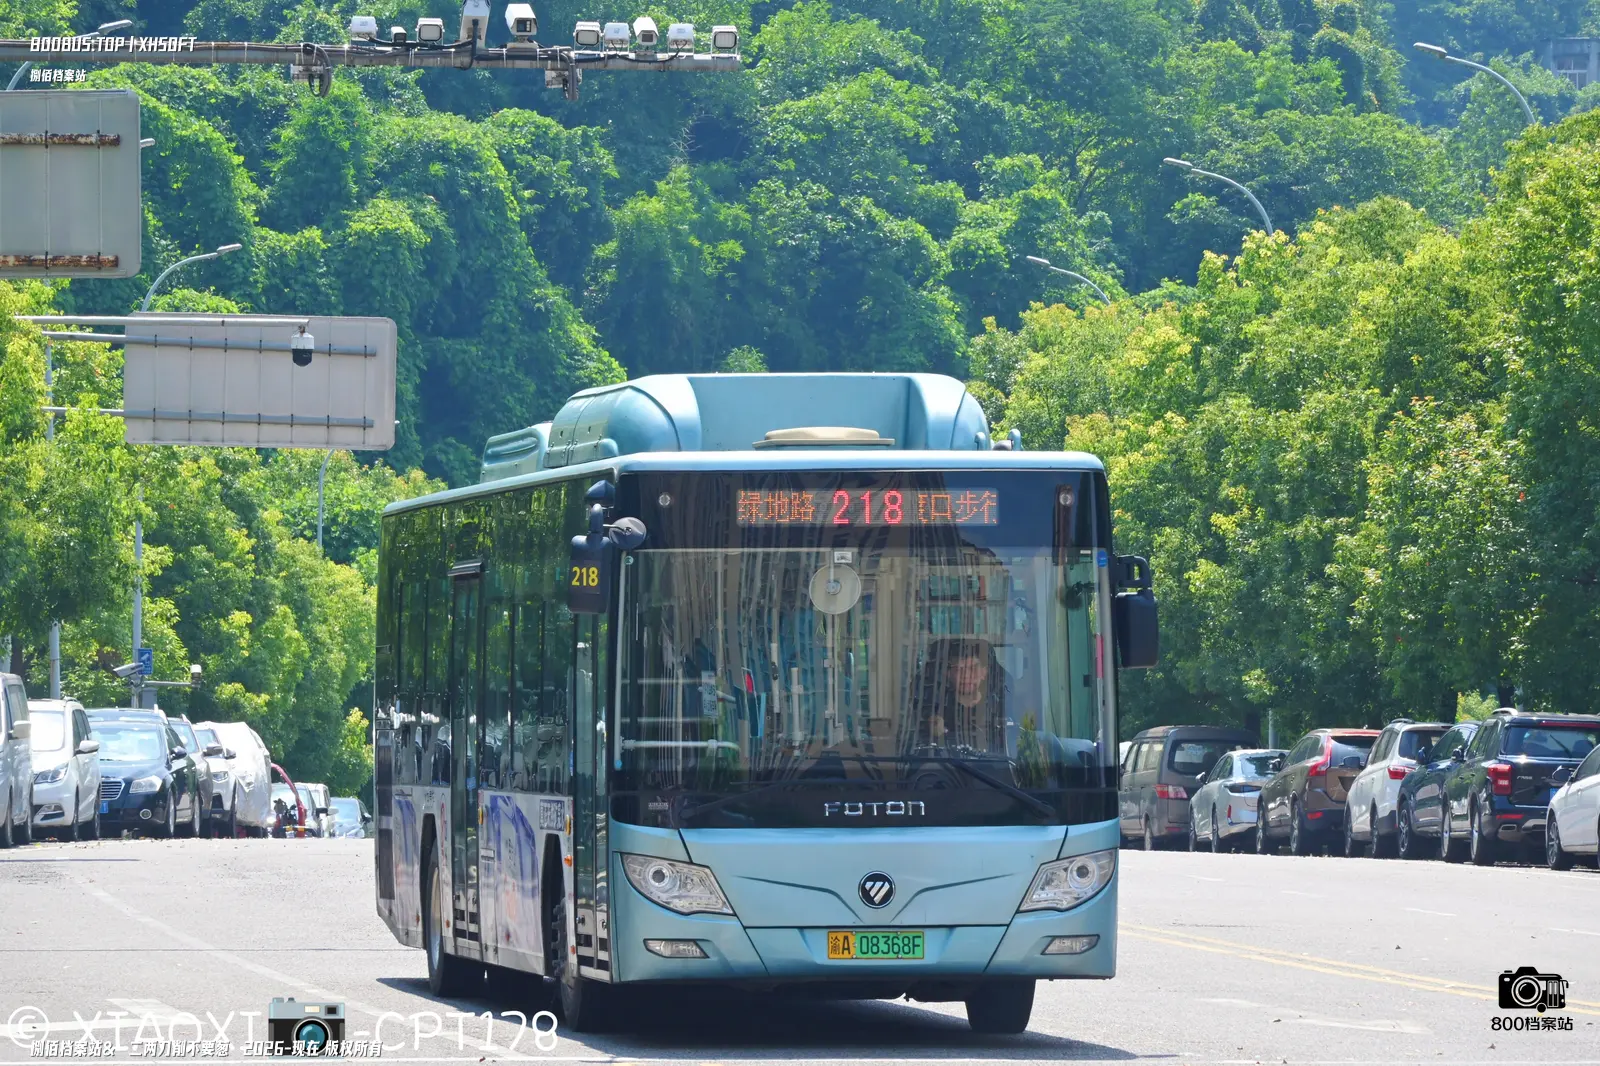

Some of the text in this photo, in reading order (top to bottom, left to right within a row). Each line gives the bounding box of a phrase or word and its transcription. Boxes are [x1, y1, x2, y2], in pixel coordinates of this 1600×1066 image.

[738, 490, 816, 524] 绿地路
[832, 490, 904, 524] 218
[571, 566, 599, 587] 218
[824, 801, 925, 817] FOTON
[859, 935, 922, 955] 08368F
